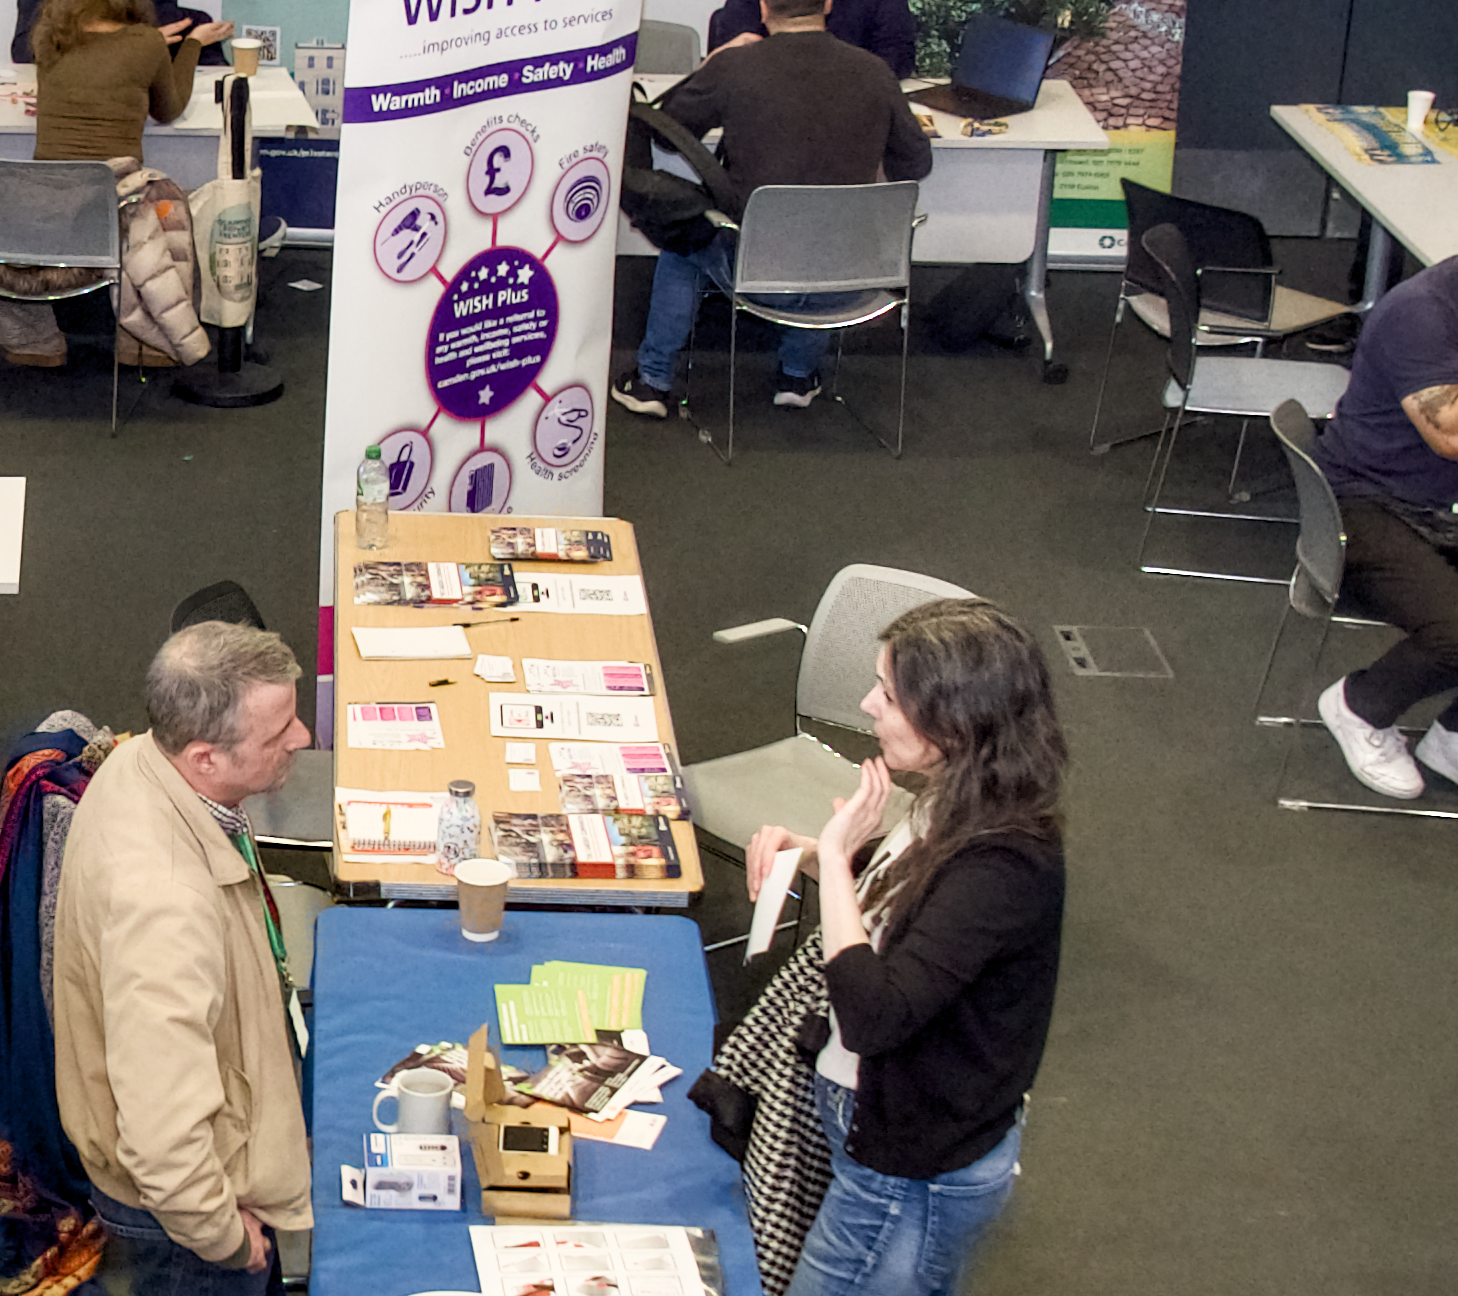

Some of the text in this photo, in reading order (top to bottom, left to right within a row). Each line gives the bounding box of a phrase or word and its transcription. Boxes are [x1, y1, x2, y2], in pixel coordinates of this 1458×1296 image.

[495, 21, 538, 39] access
[544, 16, 558, 31] to
[562, 8, 613, 28] services
[371, 45, 626, 113] Warmth Income Safety Health
[463, 112, 540, 157] Benefits checks
[558, 141, 610, 170] Fire safety
[373, 181, 449, 213] Handyperson
[453, 288, 529, 318] WISH Plus
[526, 451, 554, 481] Health
